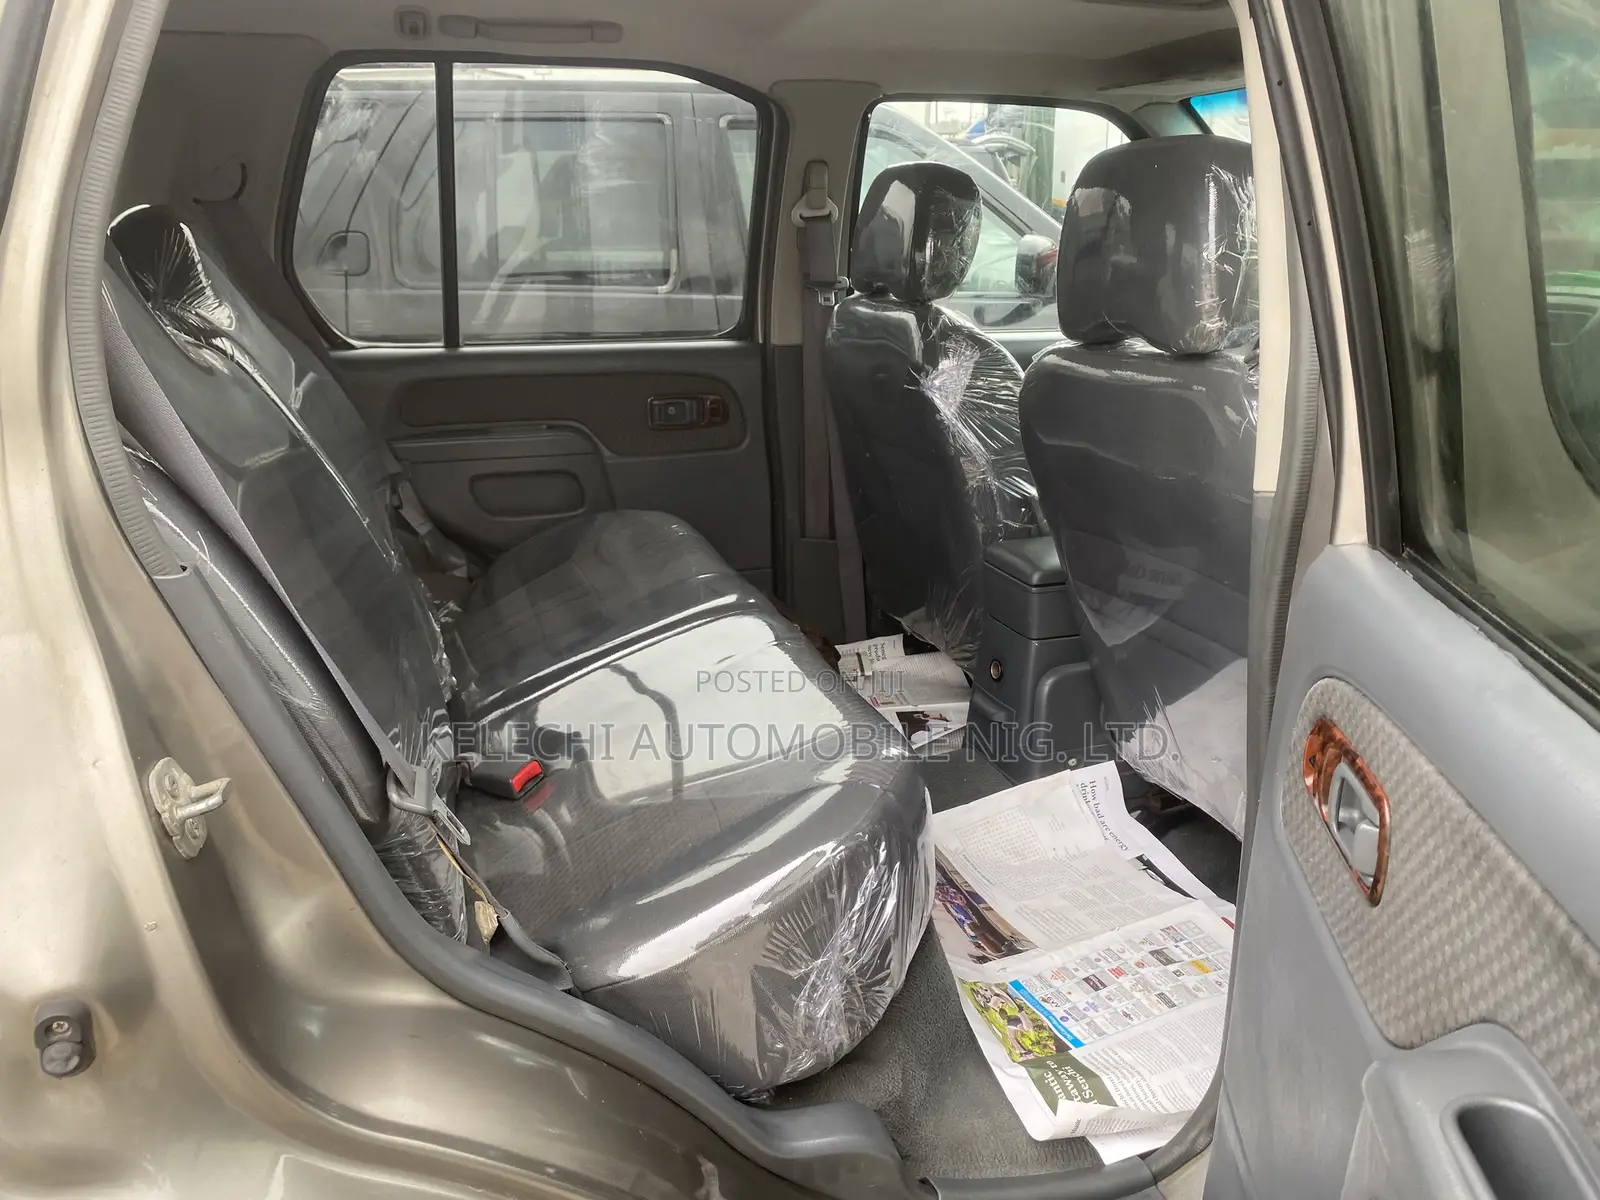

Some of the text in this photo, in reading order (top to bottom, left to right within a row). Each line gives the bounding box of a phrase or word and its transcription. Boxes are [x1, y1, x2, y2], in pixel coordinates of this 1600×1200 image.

[1089, 780, 1097, 800] How
[1093, 802, 1105, 819] bad
[1100, 820, 1110, 831] are
[1108, 831, 1129, 851] energy
[1062, 1065, 1094, 1099] Senchi
